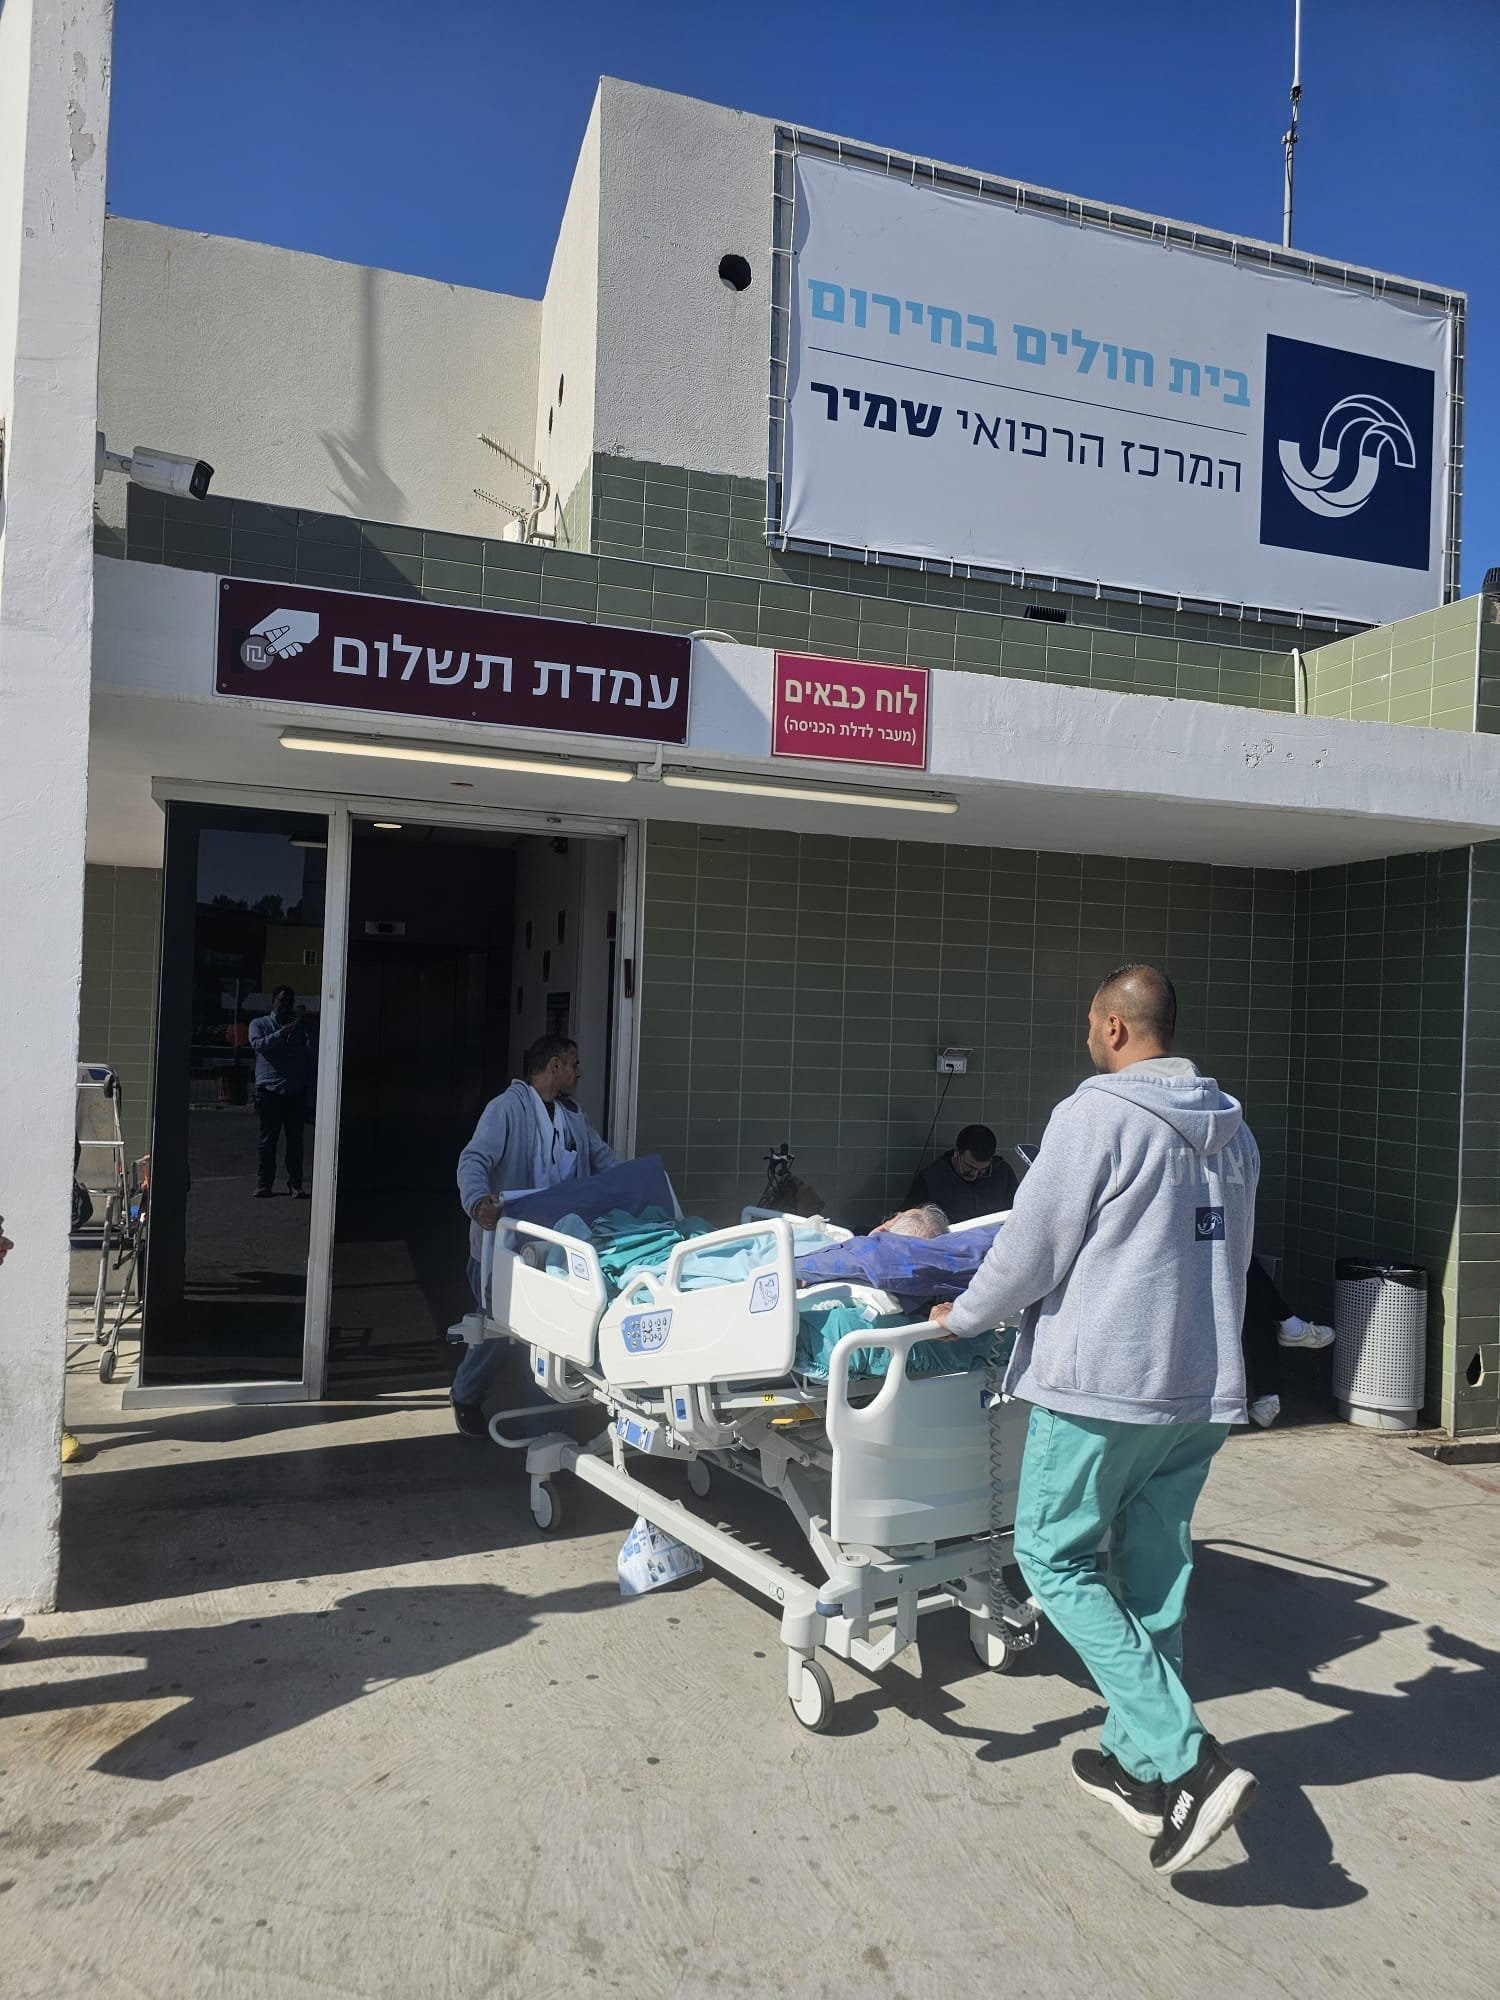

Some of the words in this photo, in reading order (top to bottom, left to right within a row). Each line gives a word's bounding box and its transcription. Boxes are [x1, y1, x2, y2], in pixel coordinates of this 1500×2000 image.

[807, 279, 997, 356] בחירום
[1012, 324, 1155, 387] חולים
[1169, 358, 1250, 407] בית
[810, 381, 943, 438] שמיר
[956, 409, 1104, 468] הרפואי
[1120, 440, 1242, 493] המרכז
[332, 632, 513, 693] תשלום
[532, 659, 679, 710] עמדת
[784, 679, 866, 710] כבאים
[876, 684, 918, 716] לוח
[784, 714, 836, 735] הכניסה)
[839, 721, 875, 739] לדלת
[877, 726, 917, 746] (מעבר
[1170, 1789, 1195, 1831] HOKA
